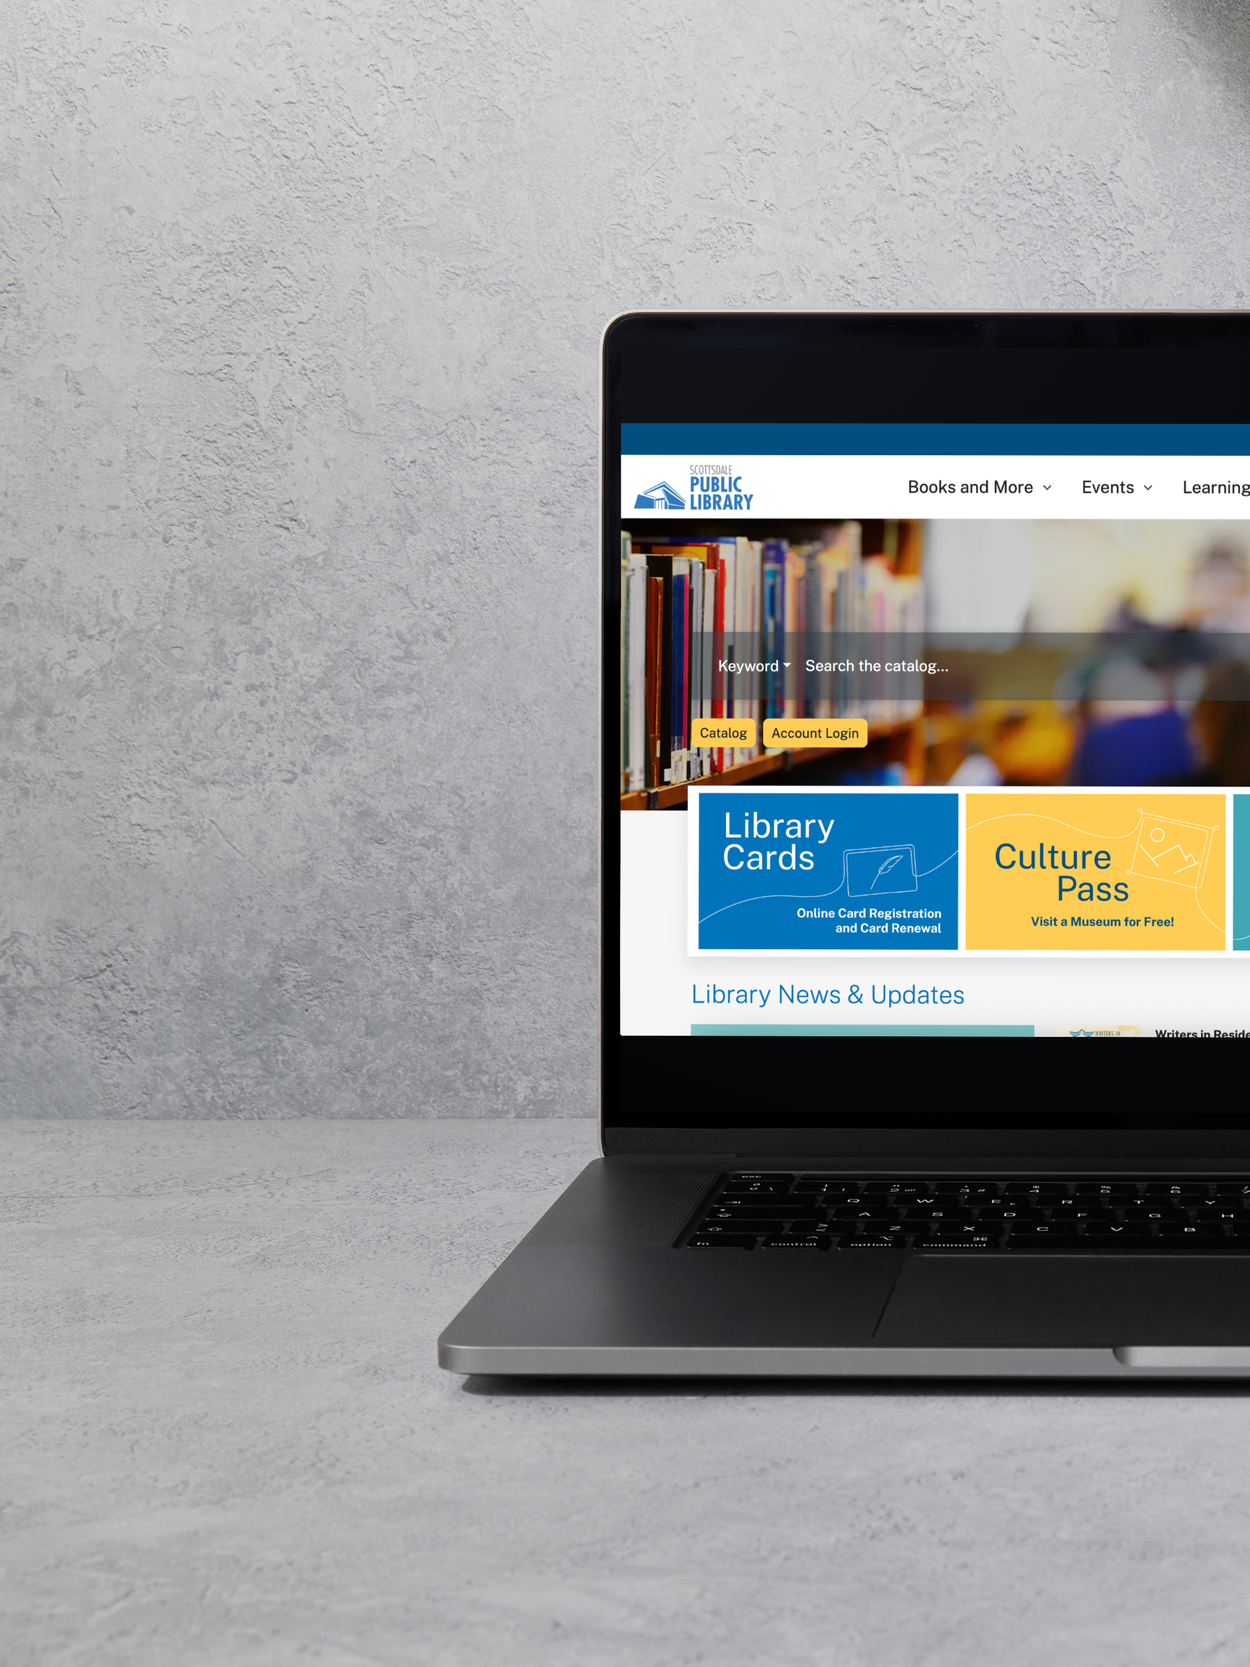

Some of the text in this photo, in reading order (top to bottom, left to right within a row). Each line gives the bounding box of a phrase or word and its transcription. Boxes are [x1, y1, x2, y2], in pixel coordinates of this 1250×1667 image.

[690, 465, 732, 475] SCOTTSDALE
[690, 477, 742, 492] PUBLIC
[909, 480, 1033, 493] Books and More
[1083, 480, 1134, 493] Events
[1184, 481, 1250, 496] Learning
[689, 493, 754, 511] LIBRARY
[718, 659, 779, 675] Keyword
[805, 659, 948, 675] Search the catalog...
[700, 728, 747, 740] Catalog
[772, 728, 858, 740] Account Login
[726, 812, 834, 843] Library
[724, 845, 814, 870] Cards
[996, 843, 1111, 869] Culture
[1059, 876, 1128, 901] Pass
[797, 908, 941, 920] Online Card Registration
[1031, 917, 1057, 926] Visit
[1071, 917, 1121, 926] Museum
[1124, 917, 1141, 926] for
[1144, 917, 1174, 926] Free!
[836, 923, 941, 933] and Card Renewal
[693, 984, 964, 1008] Library News & Updates
